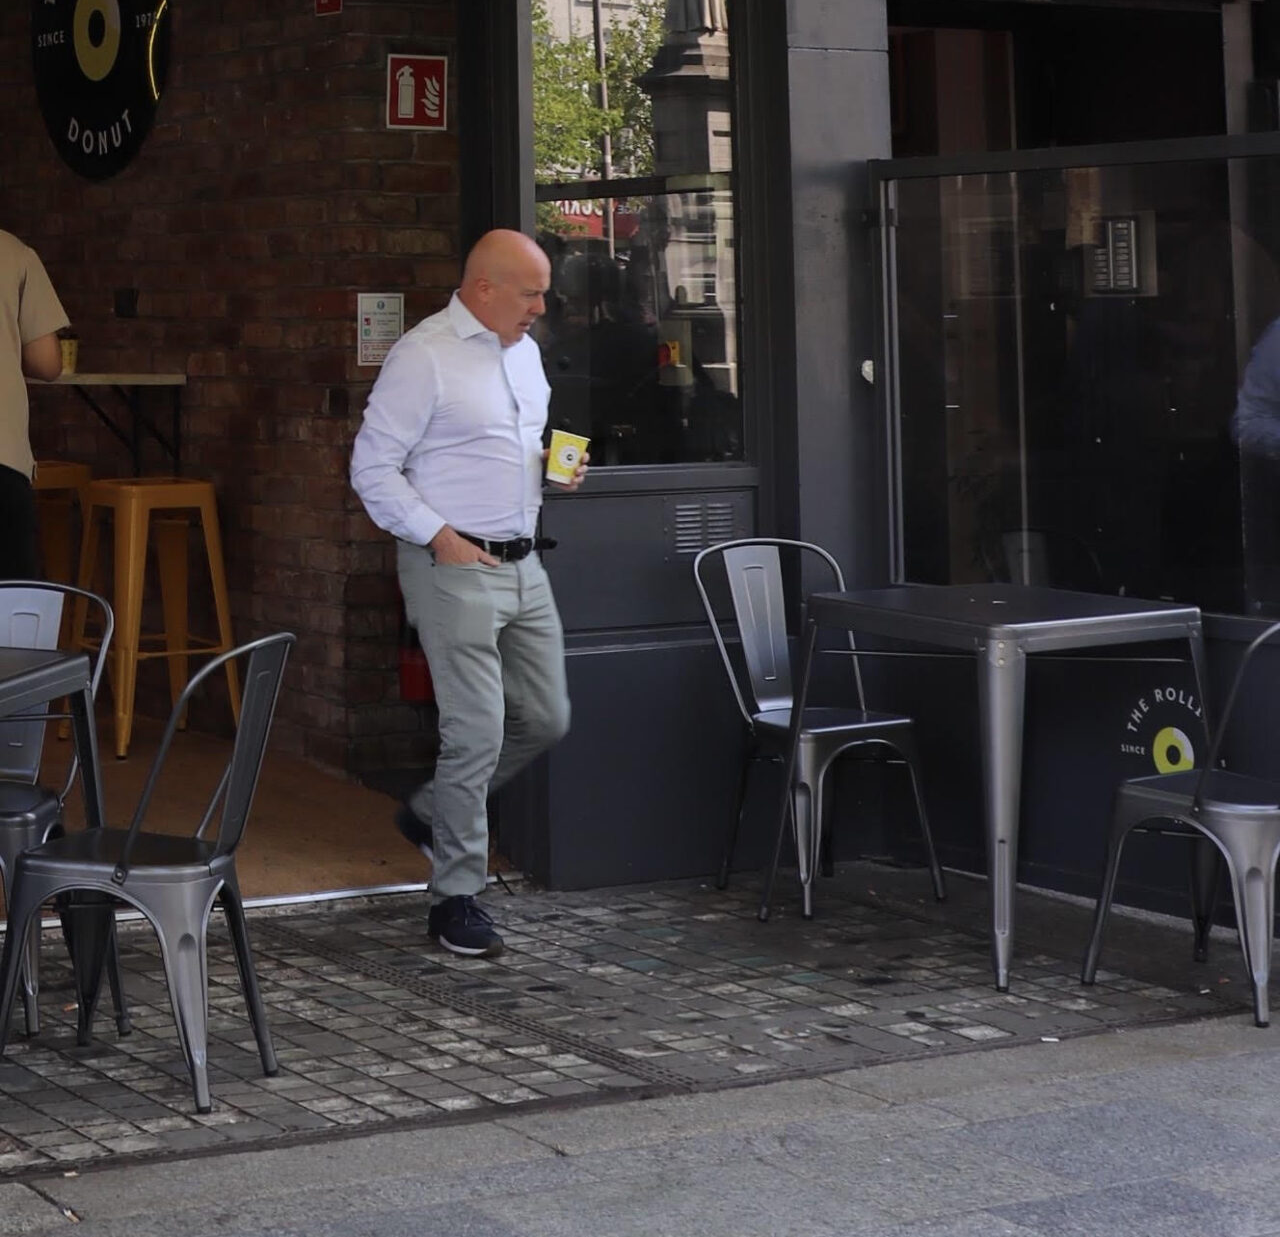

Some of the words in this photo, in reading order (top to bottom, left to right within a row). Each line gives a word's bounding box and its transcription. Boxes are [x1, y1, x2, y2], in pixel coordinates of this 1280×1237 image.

[37, 29, 66, 49] SINCE
[66, 107, 133, 156] DONUT
[1126, 698, 1150, 733] THE
[1120, 743, 1146, 756] SINCE
